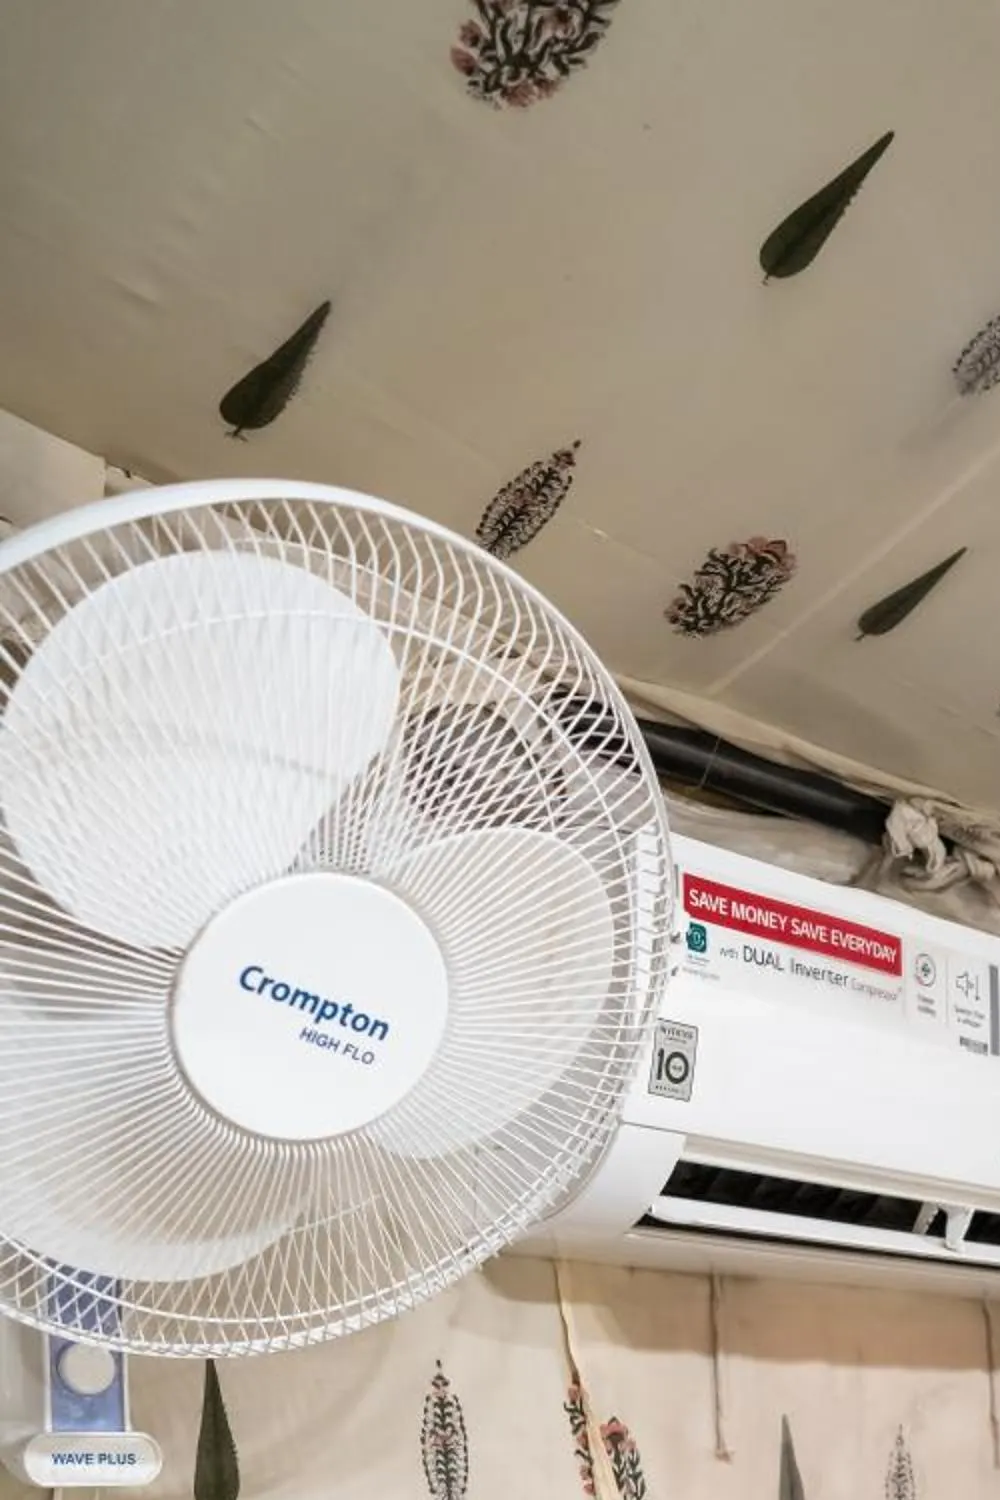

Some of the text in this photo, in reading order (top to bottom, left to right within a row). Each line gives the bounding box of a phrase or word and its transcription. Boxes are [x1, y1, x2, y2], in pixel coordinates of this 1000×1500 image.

[689, 888, 898, 964] SAVE MONEY SAVE EVERYDAY
[743, 945, 784, 972] DUAL
[790, 957, 851, 987] Inverter
[239, 965, 390, 1041] Crompton
[299, 1027, 376, 1066] HIGH FLO
[656, 1047, 690, 1084] 10
[51, 1453, 137, 1465] WAVE PLUS
